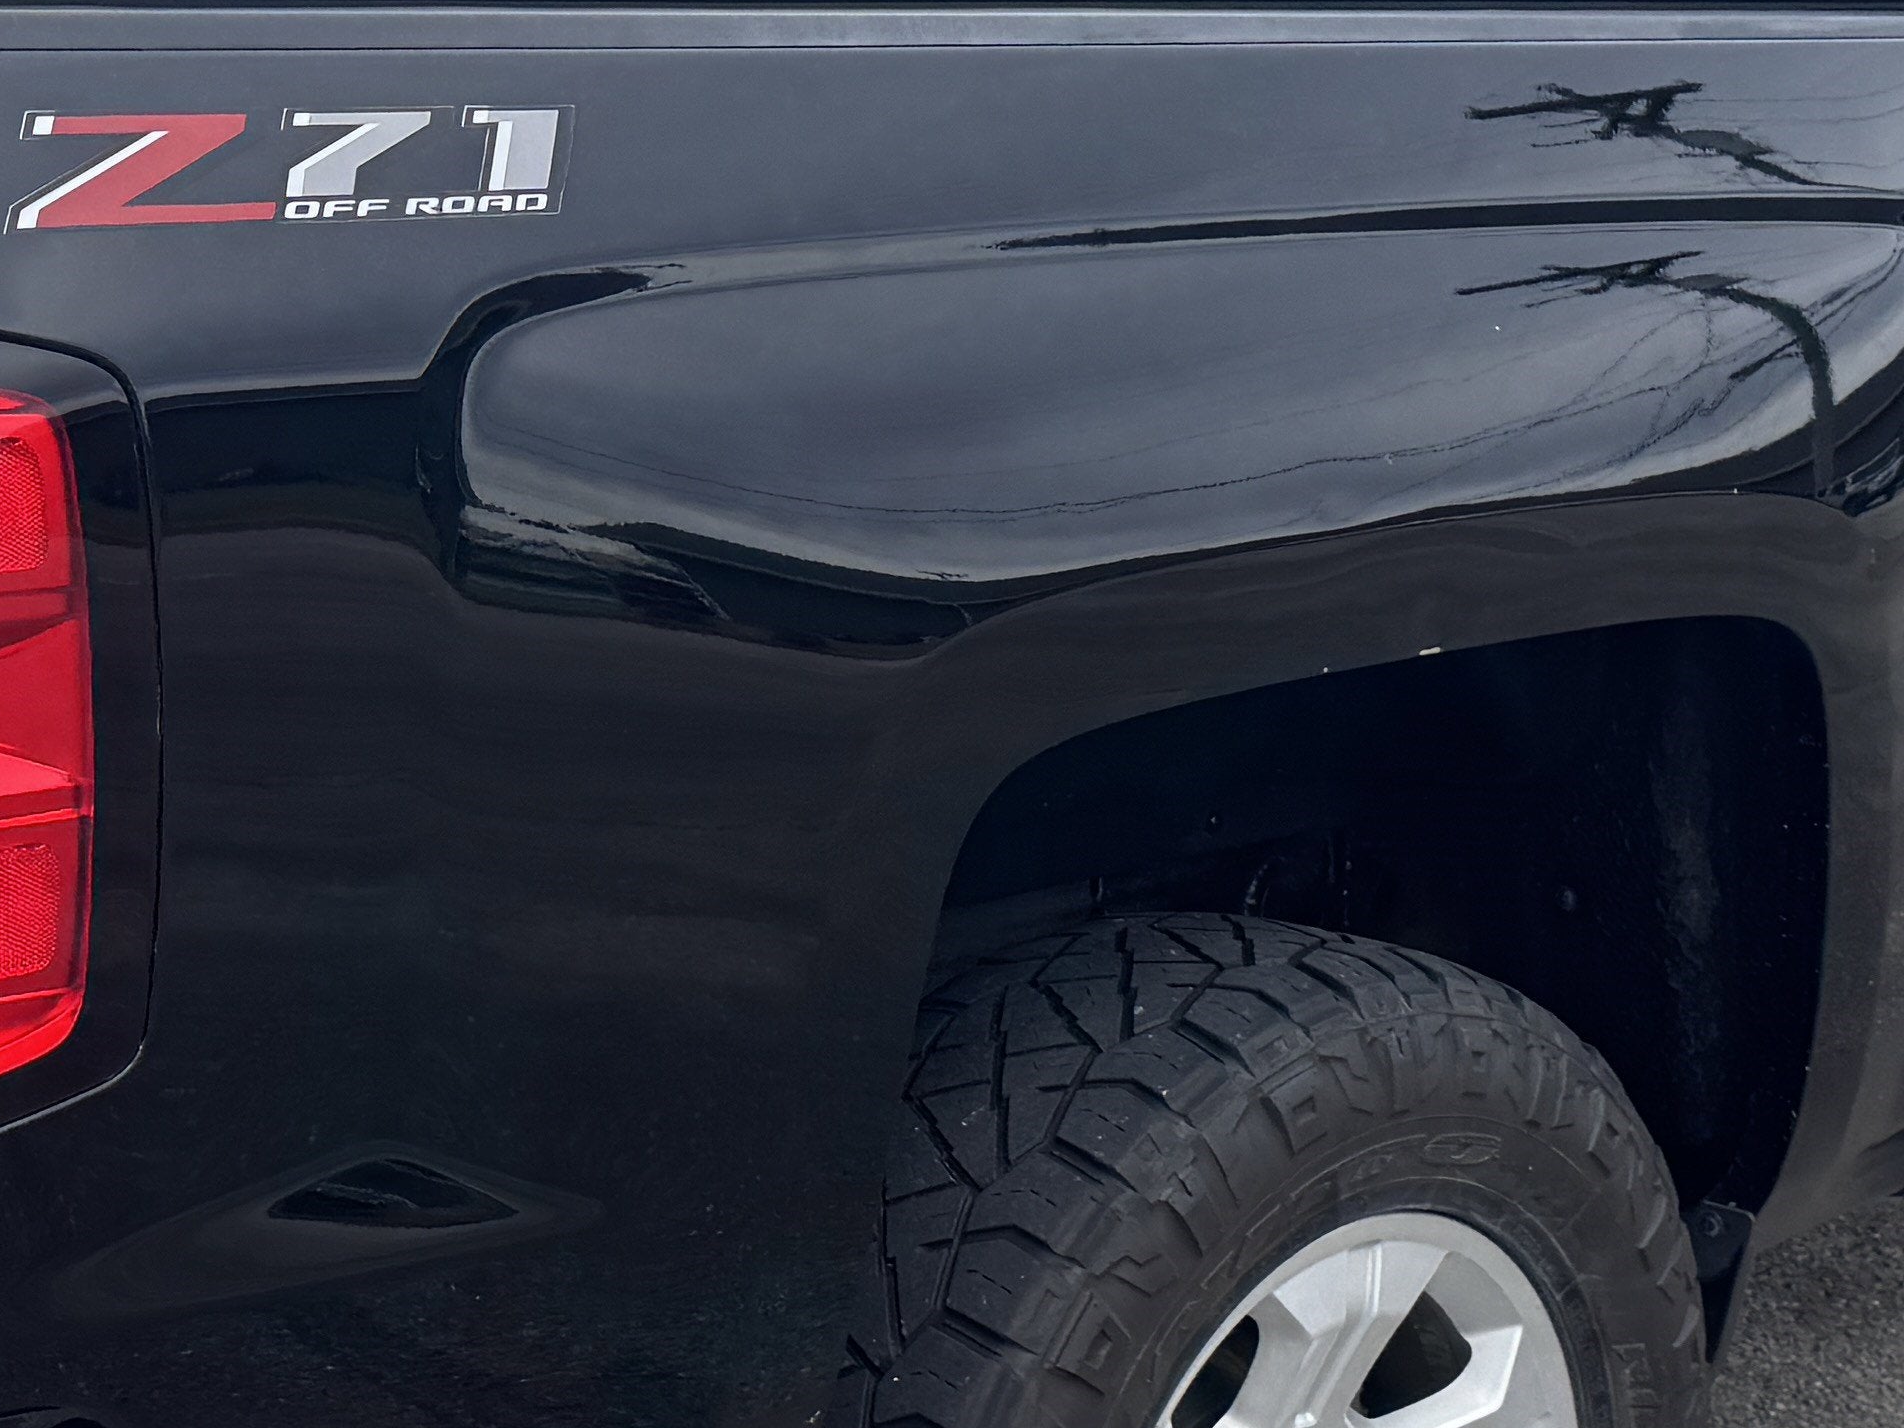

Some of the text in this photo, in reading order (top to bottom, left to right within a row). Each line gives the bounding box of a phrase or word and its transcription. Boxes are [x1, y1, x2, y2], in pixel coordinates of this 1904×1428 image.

[12, 109, 562, 230] Z71
[281, 193, 549, 220] OFF ROAD
